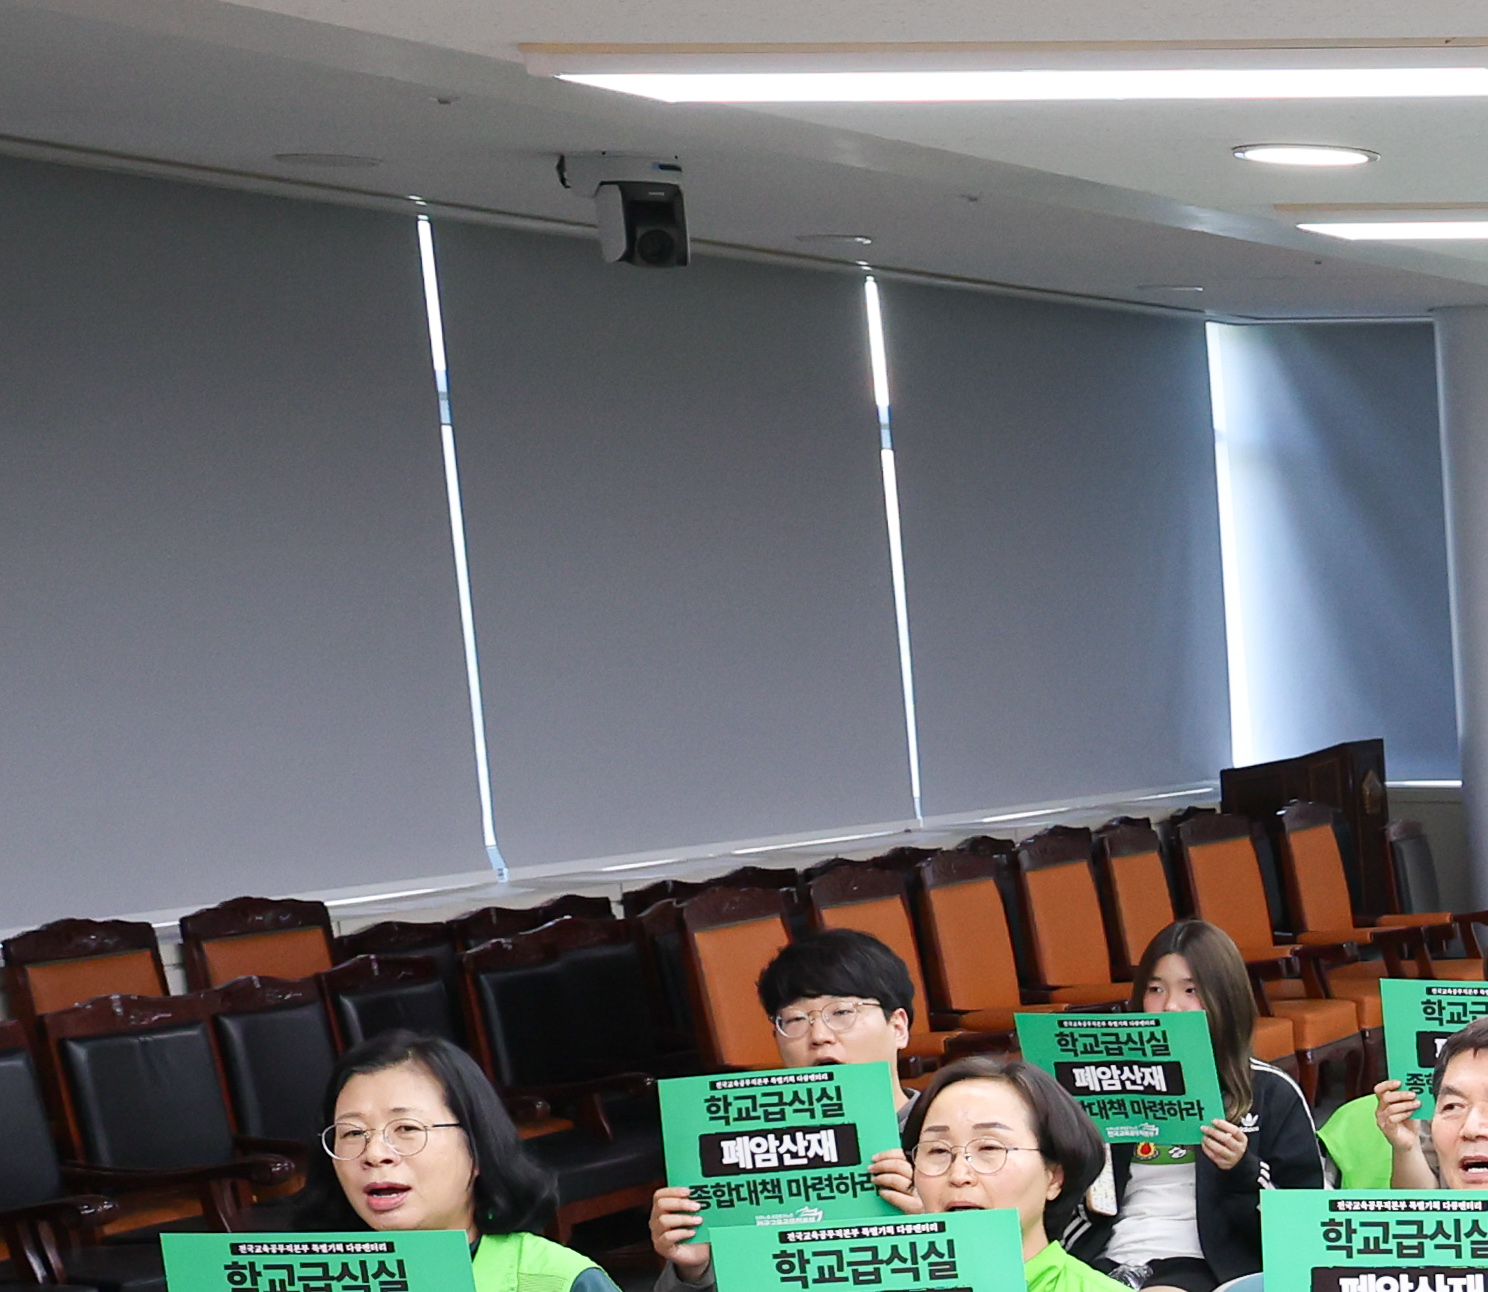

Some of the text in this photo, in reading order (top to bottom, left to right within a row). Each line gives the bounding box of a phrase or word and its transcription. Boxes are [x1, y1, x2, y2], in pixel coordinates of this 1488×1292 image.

[1053, 1030, 1170, 1057] 학교급식실
[1073, 1064, 1167, 1090] 폐암산재
[700, 1085, 845, 1126] 학교급식실
[1128, 1099, 1204, 1120] 마련하라
[720, 1129, 837, 1169] 폐암산재
[687, 1177, 783, 1210] 종합대책
[1408, 1200, 1440, 1210] 특별기획
[861, 1225, 894, 1236] 특별기획
[771, 1238, 958, 1289] 학교급식실
